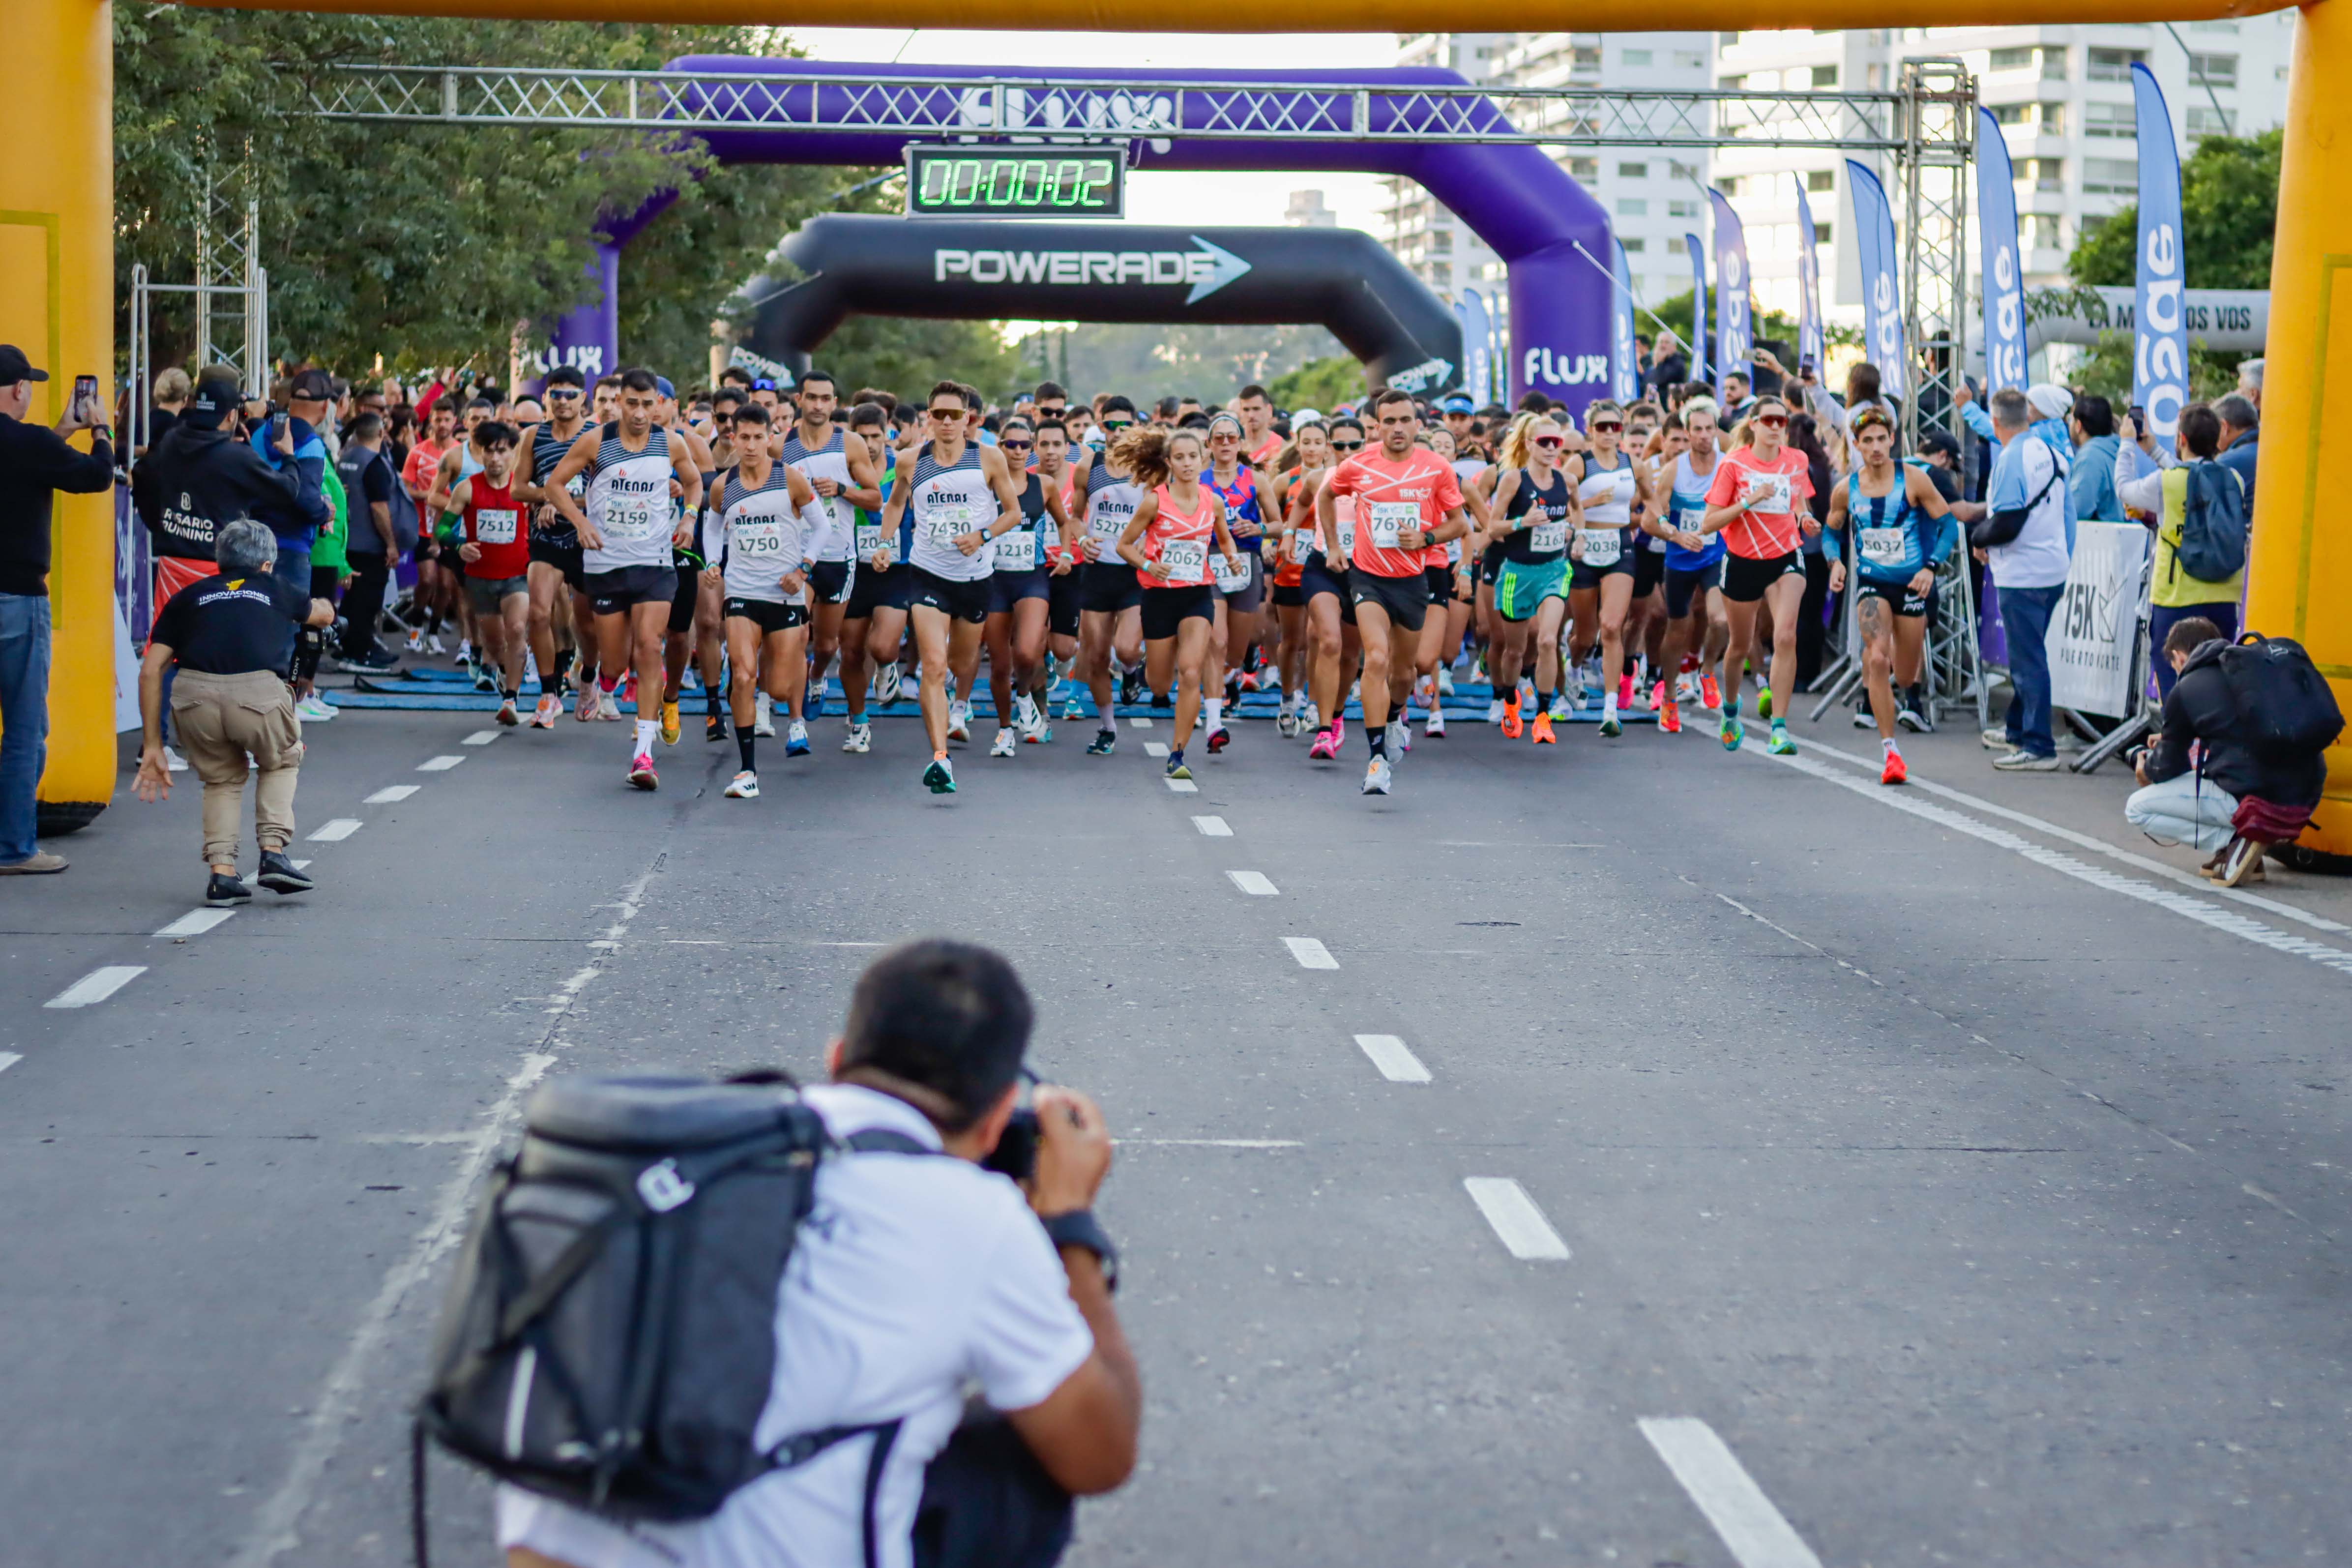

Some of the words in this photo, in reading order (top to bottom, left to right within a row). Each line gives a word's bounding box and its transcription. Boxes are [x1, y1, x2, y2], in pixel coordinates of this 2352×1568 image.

[918, 158, 1114, 207] 00:00:02
[934, 249, 1216, 285] POWERADE
[2216, 306, 2250, 330] VOS
[607, 509, 648, 525] 2159
[478, 519, 514, 532] 7512
[928, 521, 971, 536] 7430
[738, 536, 779, 552] 1750
[859, 537, 898, 549] 201
[995, 544, 1033, 557] 1218
[1585, 541, 1618, 552] 2038
[1864, 539, 1902, 554] 5037
[1163, 550, 1203, 566] 2062
[1212, 564, 1249, 579] 210
[199, 590, 271, 603] INNOVACIONES
[2064, 583, 2096, 640] 15K
[291, 656, 300, 681] SONY
